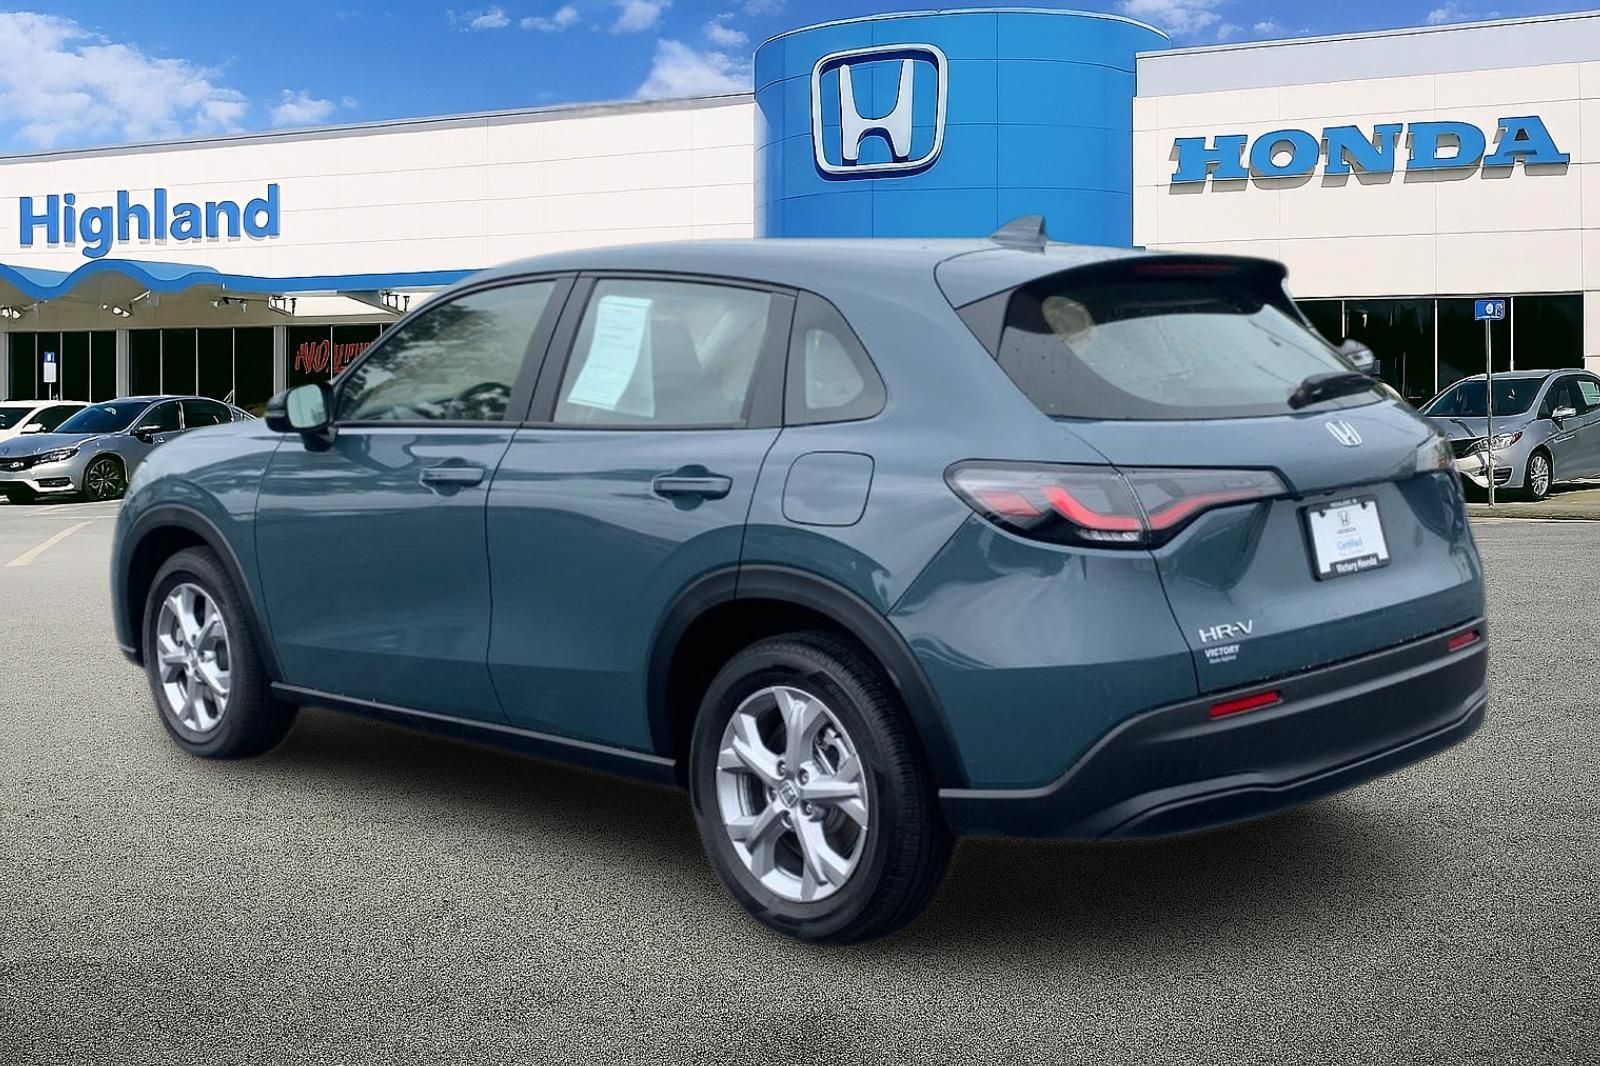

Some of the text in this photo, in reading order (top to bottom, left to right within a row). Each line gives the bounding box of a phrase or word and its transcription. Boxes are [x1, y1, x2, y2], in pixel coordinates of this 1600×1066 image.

[1171, 115, 1571, 184] HONDA
[19, 183, 281, 258] Highland
[1335, 556, 1378, 573] Victory Honda
[1199, 619, 1253, 643] HR-V
[1204, 644, 1240, 658] VICTORY
